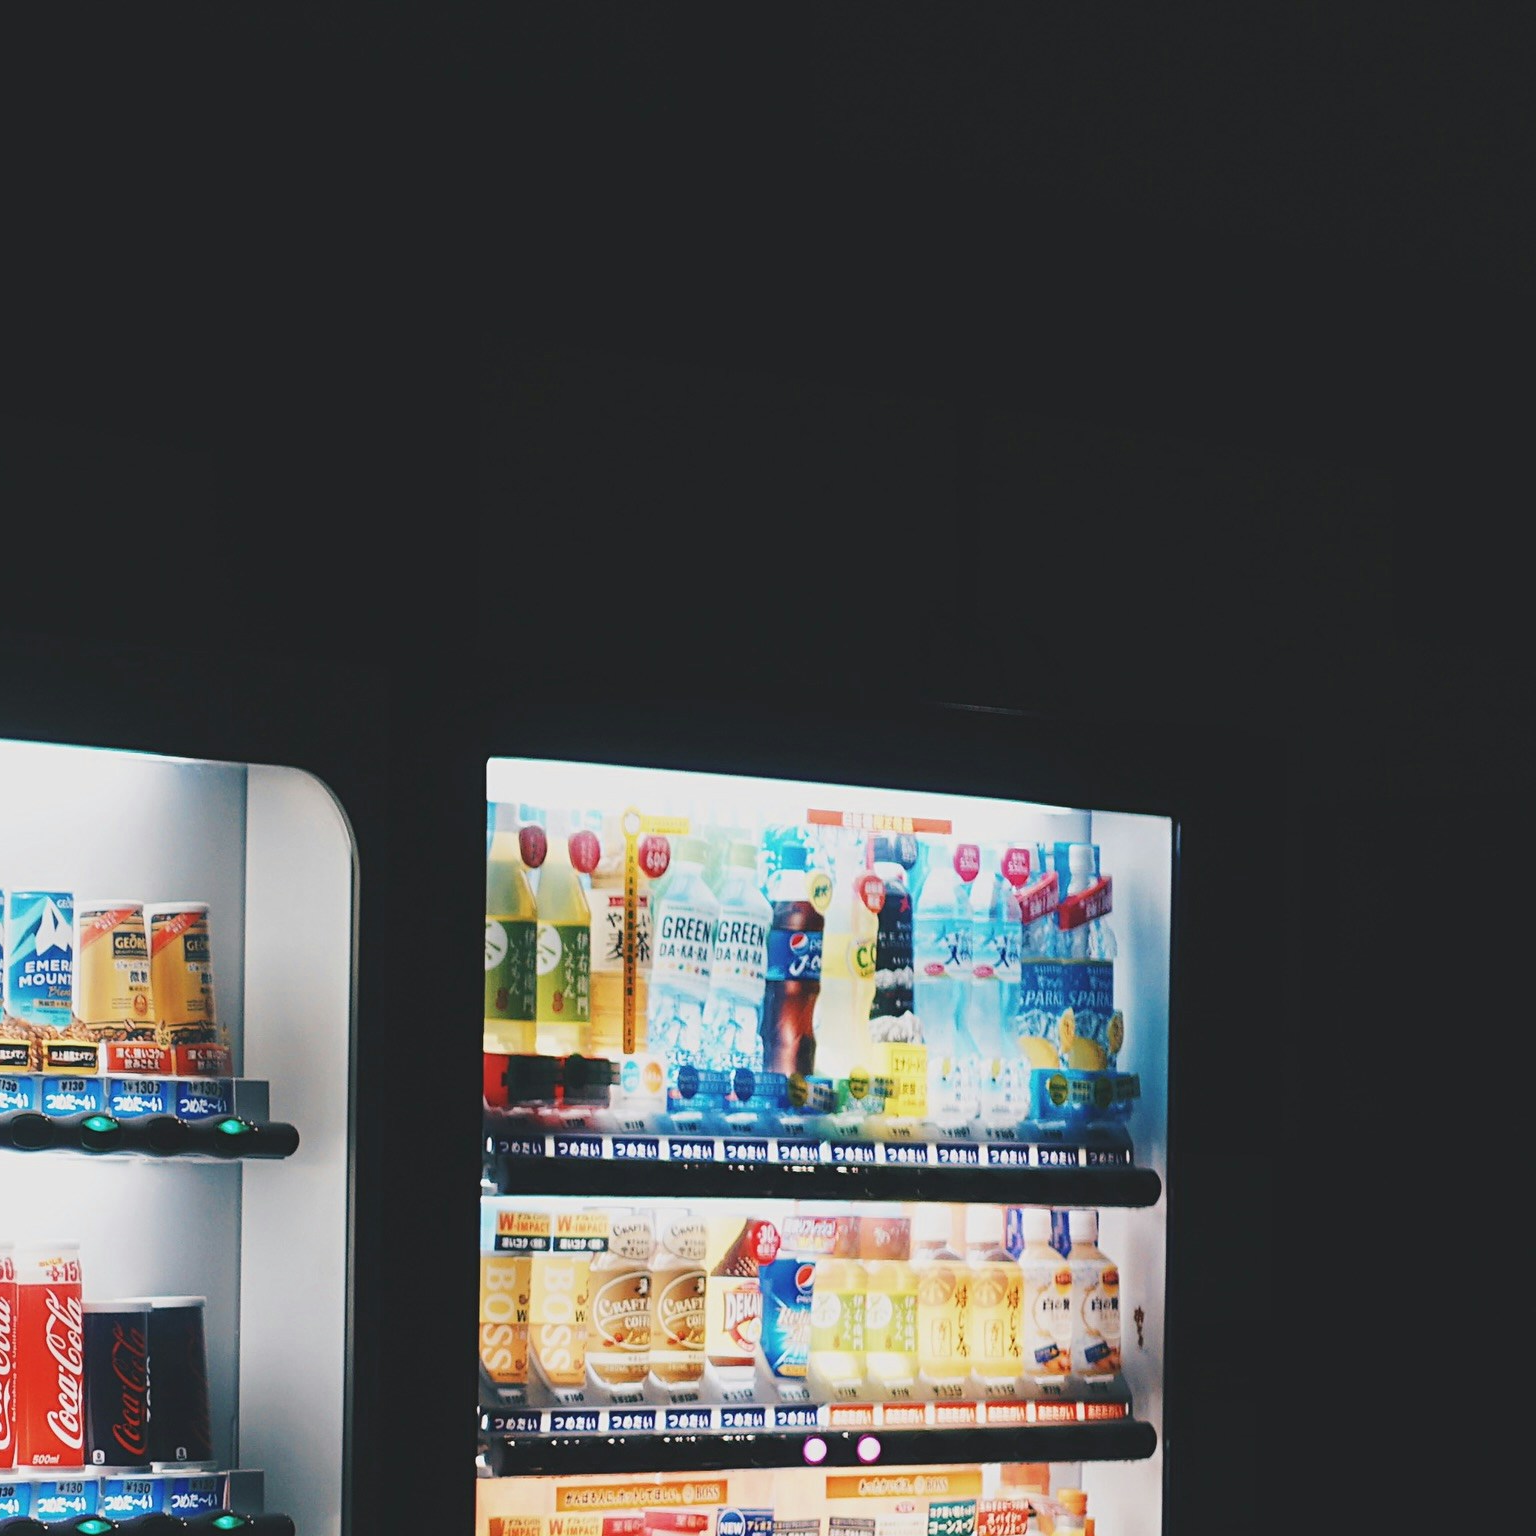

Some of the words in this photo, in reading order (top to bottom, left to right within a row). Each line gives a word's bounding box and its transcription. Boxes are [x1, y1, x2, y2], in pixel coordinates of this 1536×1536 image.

[662, 916, 711, 943] GREEN
[718, 920, 765, 947] GREEN
[61, 1079, 84, 1092] ¥130
[482, 1266, 516, 1371] BOSS
[541, 1267, 574, 1371] BOSS
[33, 1453, 61, 1466] 500ml
[719, 1521, 743, 1535] NEW
